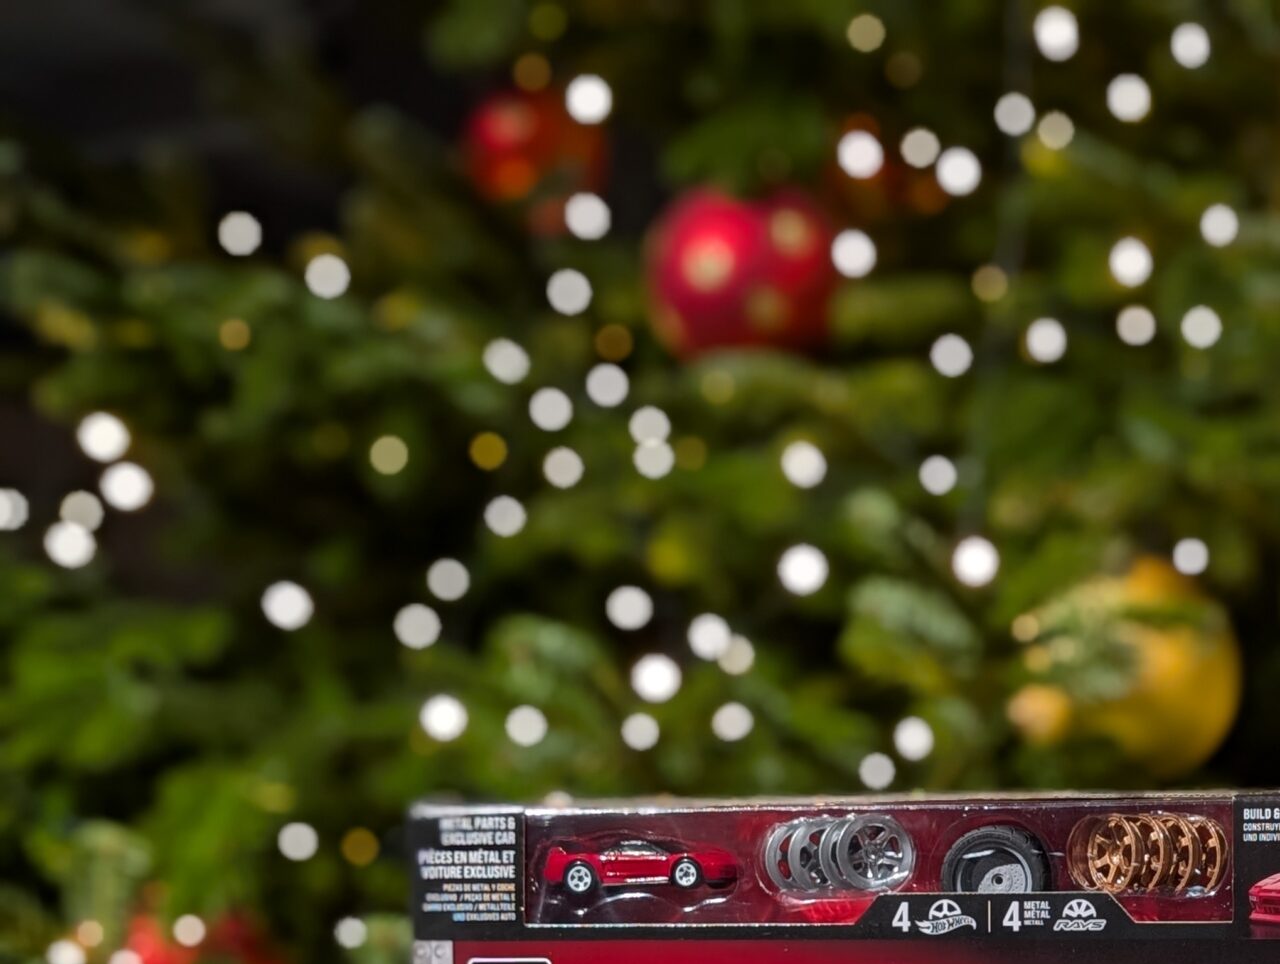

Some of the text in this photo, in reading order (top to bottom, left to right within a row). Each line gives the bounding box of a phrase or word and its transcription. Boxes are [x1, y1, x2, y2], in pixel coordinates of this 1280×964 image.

[1243, 808, 1271, 820] BUILD
[1273, 808, 1280, 819] &
[474, 816, 506, 830] PARTS
[495, 831, 516, 845] CAR
[1243, 832, 1257, 841] UND
[454, 850, 467, 864] EN
[468, 848, 501, 864] MÉTAL
[502, 850, 516, 863] ET
[421, 865, 516, 879] VOITURE EXCLUSIVE
[1023, 901, 1051, 910] METAL
[891, 901, 911, 932] 4
[1002, 901, 1022, 932] 4
[1054, 920, 1106, 931] RAYS
